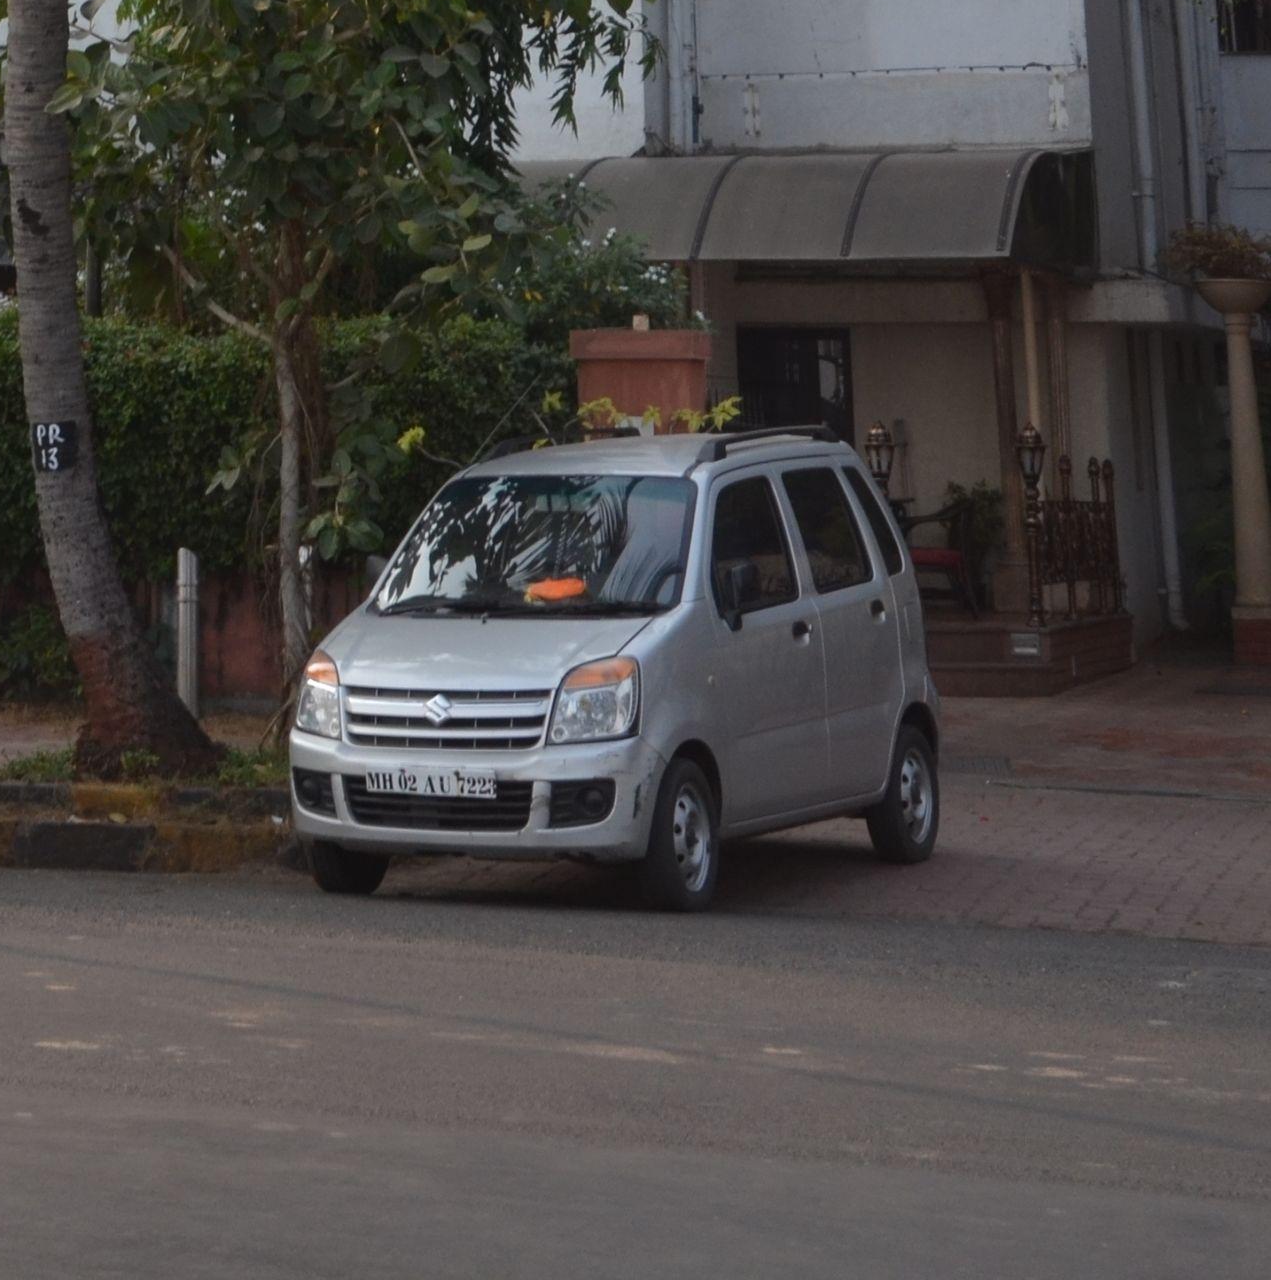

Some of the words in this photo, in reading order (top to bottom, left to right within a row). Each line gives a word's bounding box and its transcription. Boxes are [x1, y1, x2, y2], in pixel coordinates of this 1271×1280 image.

[36, 424, 65, 446] PR
[41, 447, 59, 470] 13
[368, 771, 393, 790] MH
[398, 773, 418, 791] 02
